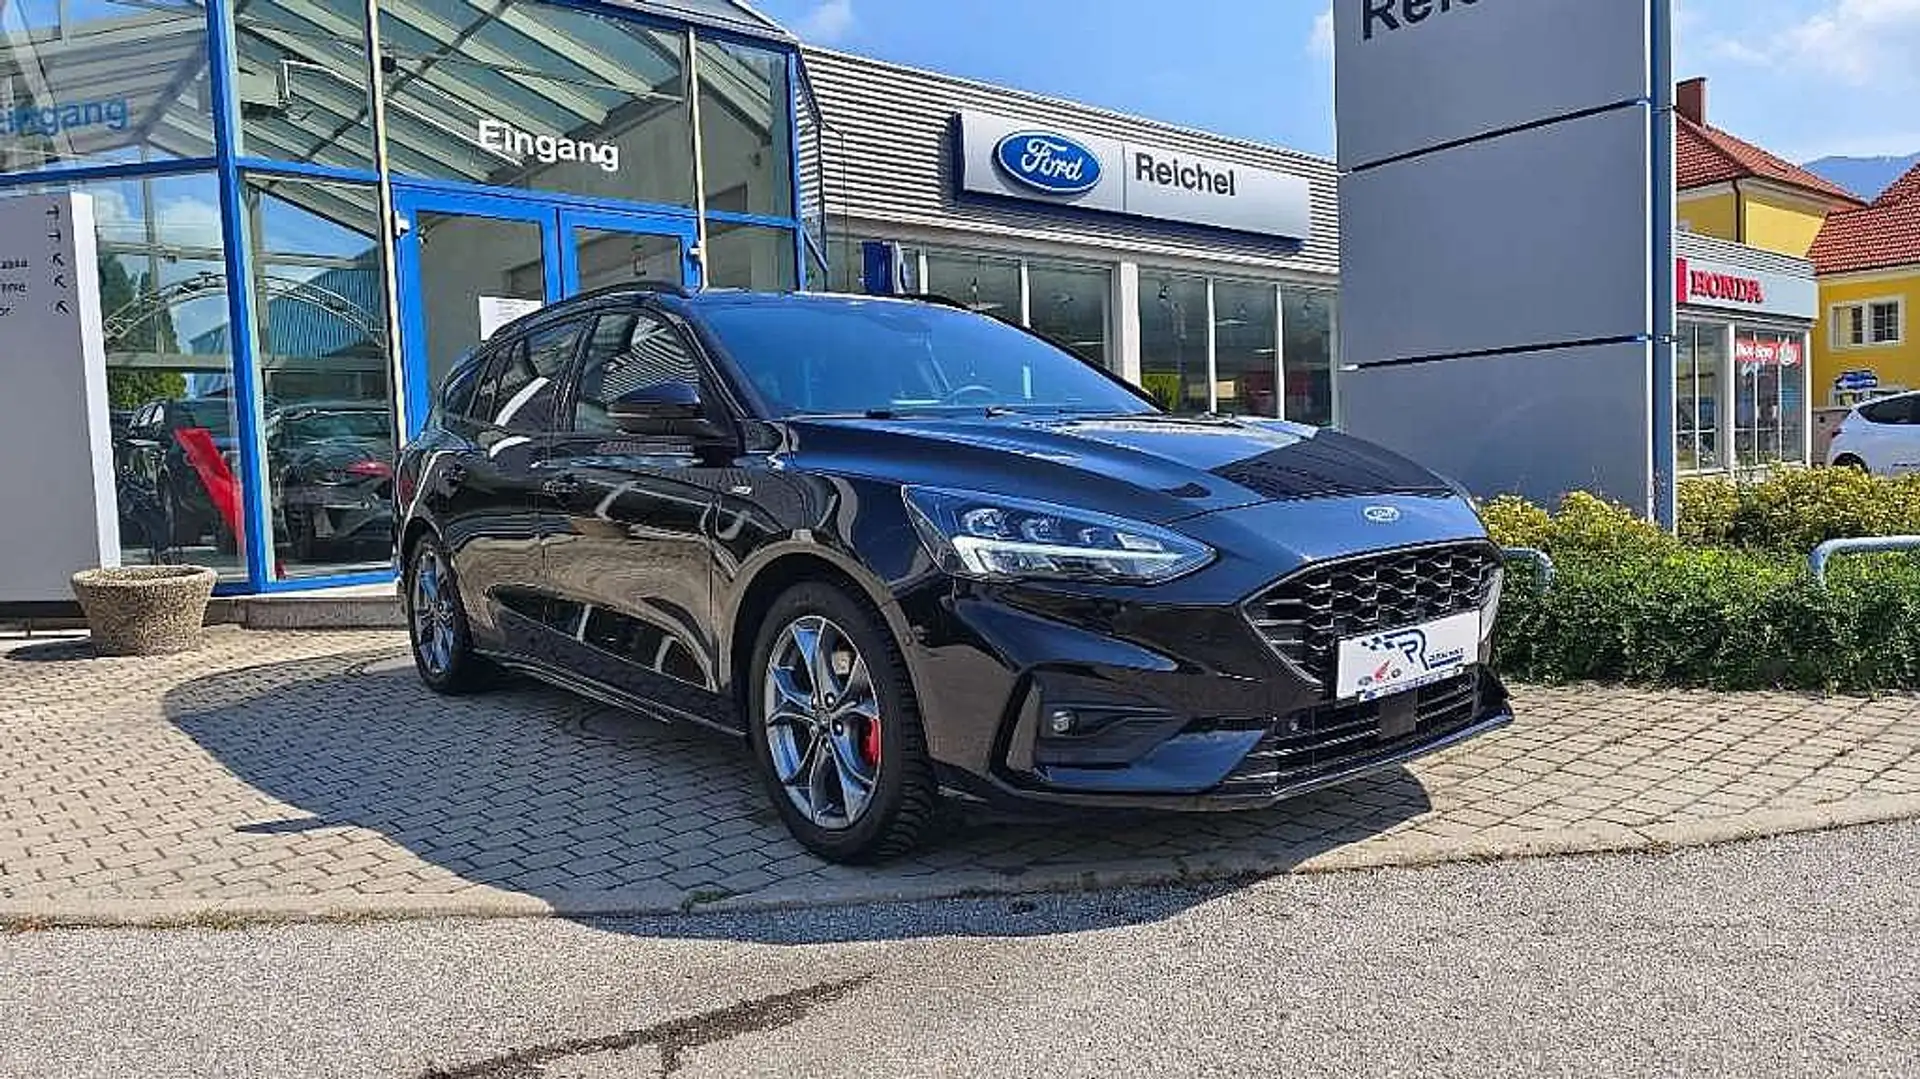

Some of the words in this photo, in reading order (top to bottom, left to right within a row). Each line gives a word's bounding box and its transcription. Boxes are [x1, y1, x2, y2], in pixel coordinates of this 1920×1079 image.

[478, 119, 619, 172] Eingang
[1021, 138, 1082, 180] Ford
[1135, 152, 1236, 196] Reichel
[1691, 270, 1763, 303] HONDA
